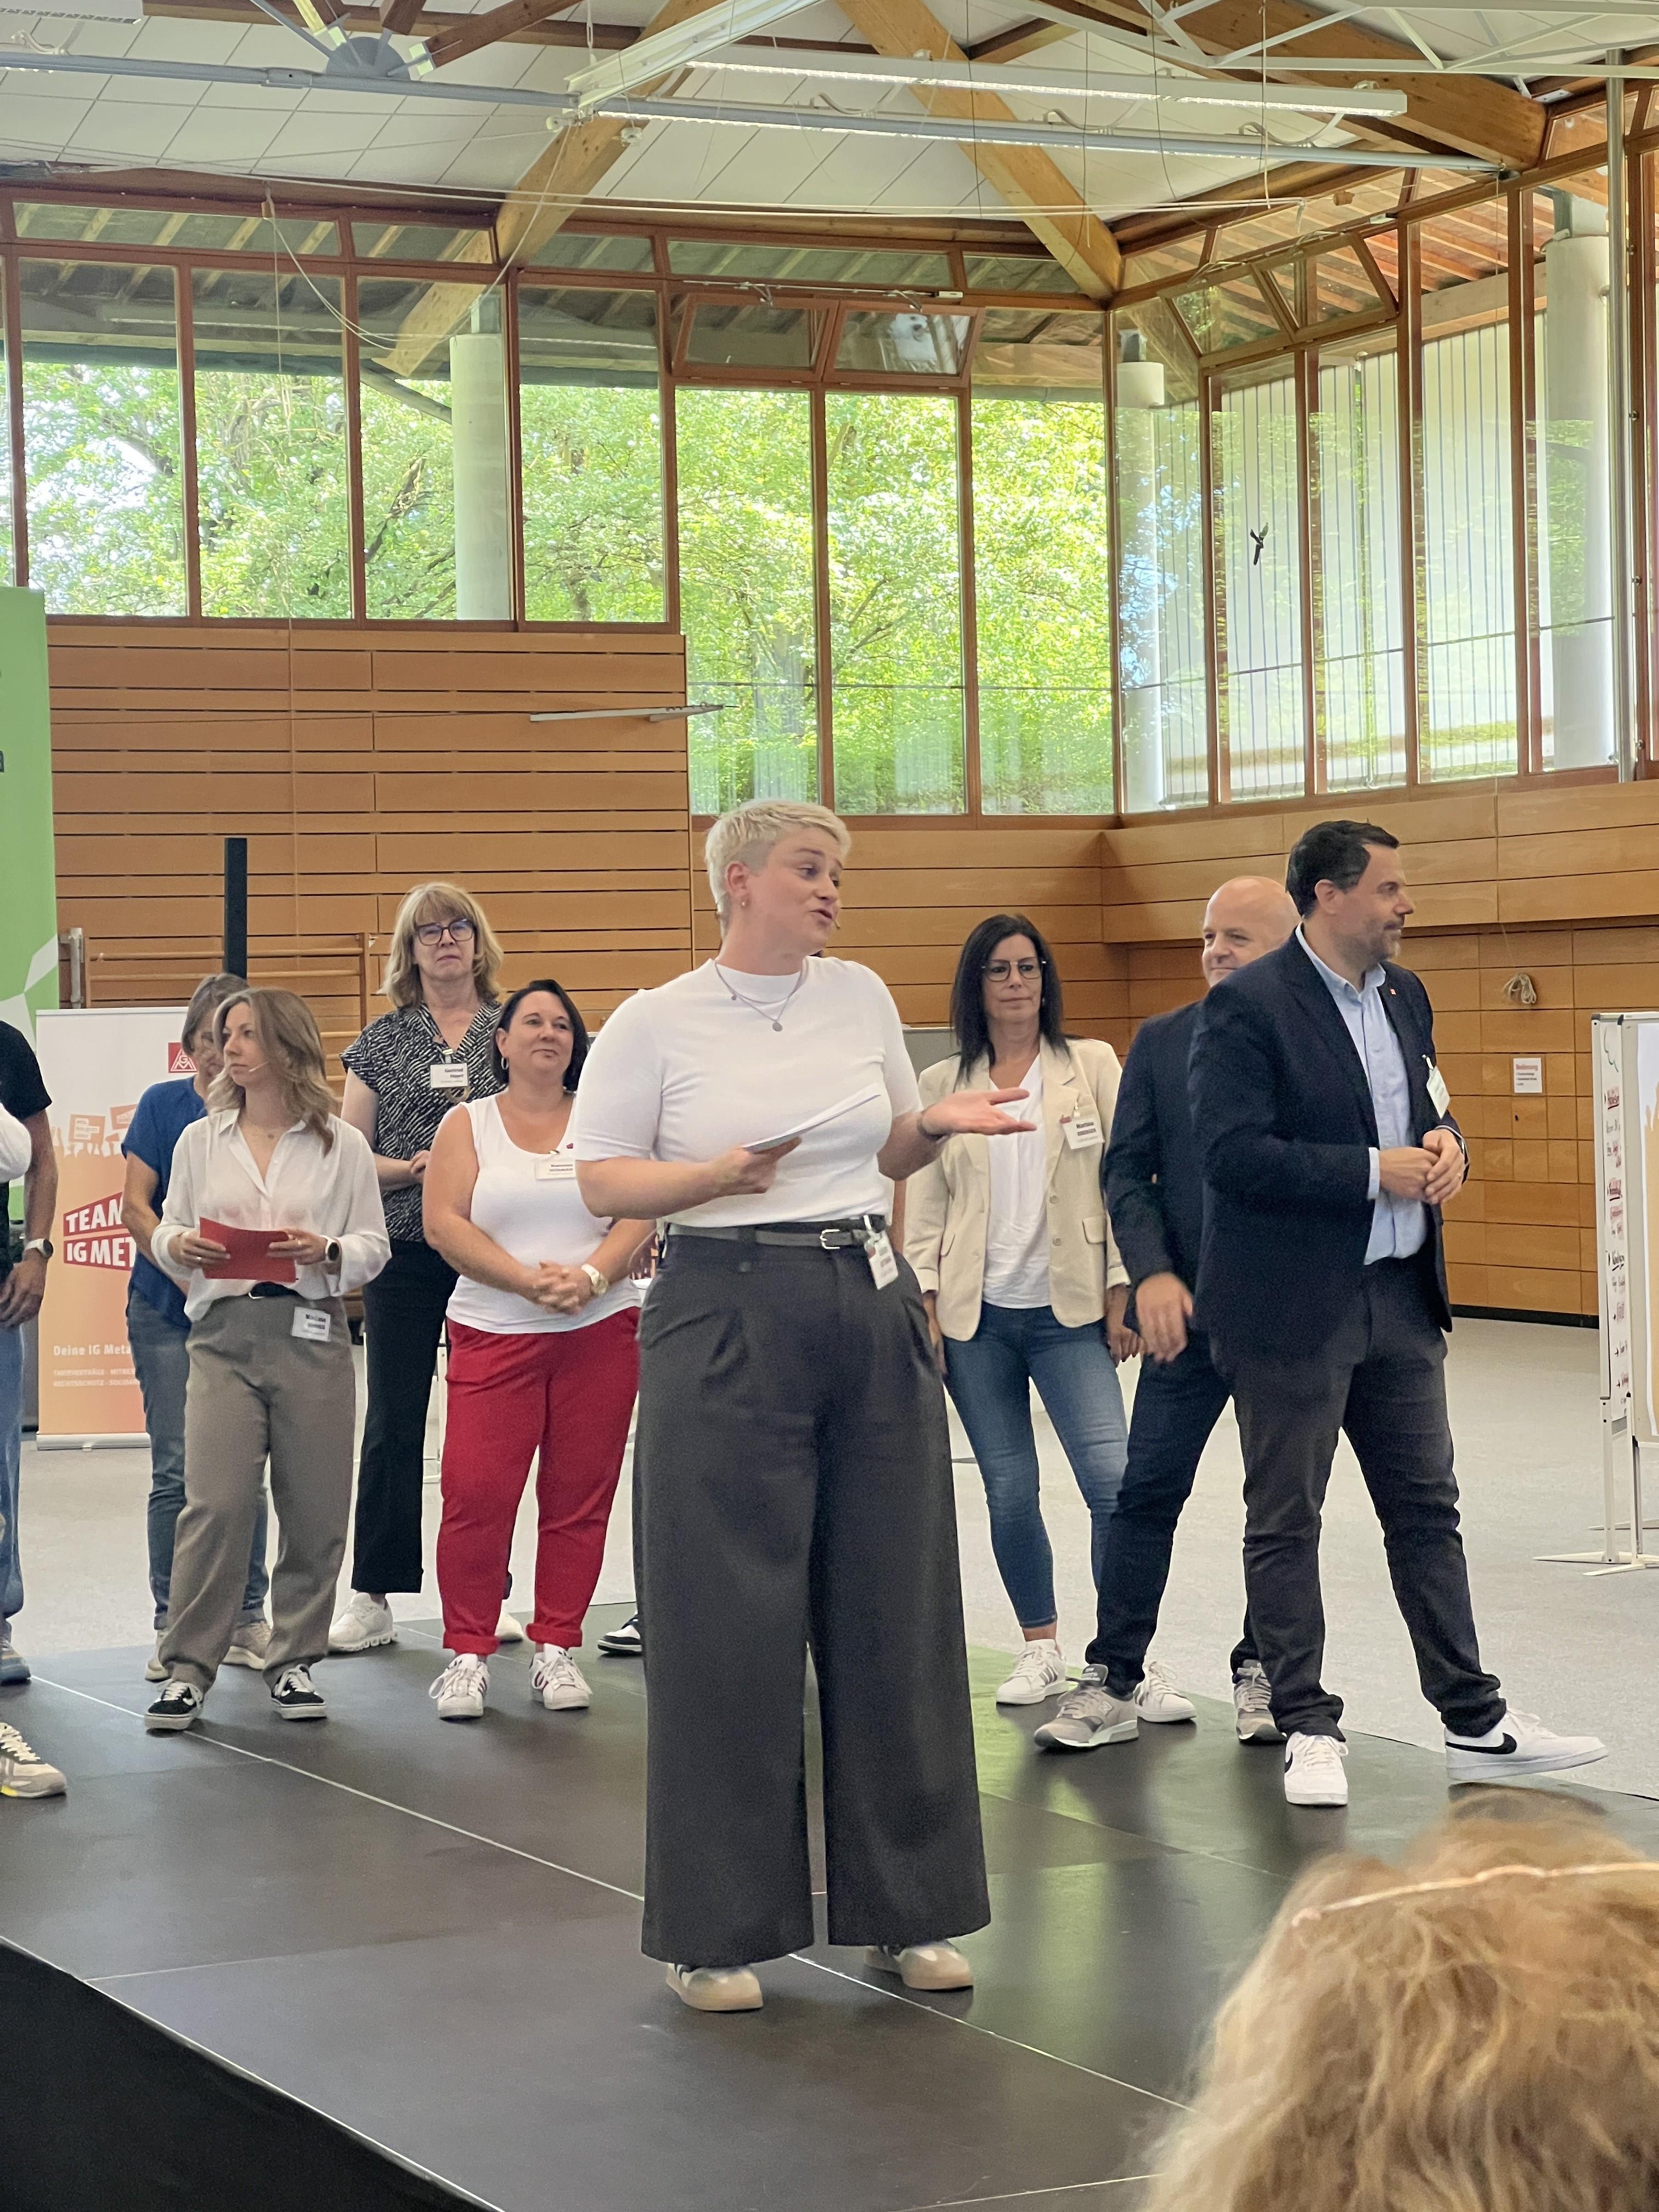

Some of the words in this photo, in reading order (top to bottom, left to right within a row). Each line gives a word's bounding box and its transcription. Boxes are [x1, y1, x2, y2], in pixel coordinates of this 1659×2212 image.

[67, 1242, 87, 1262] IG
[53, 1345, 84, 1356] Deine
[89, 1345, 100, 1355] IG
